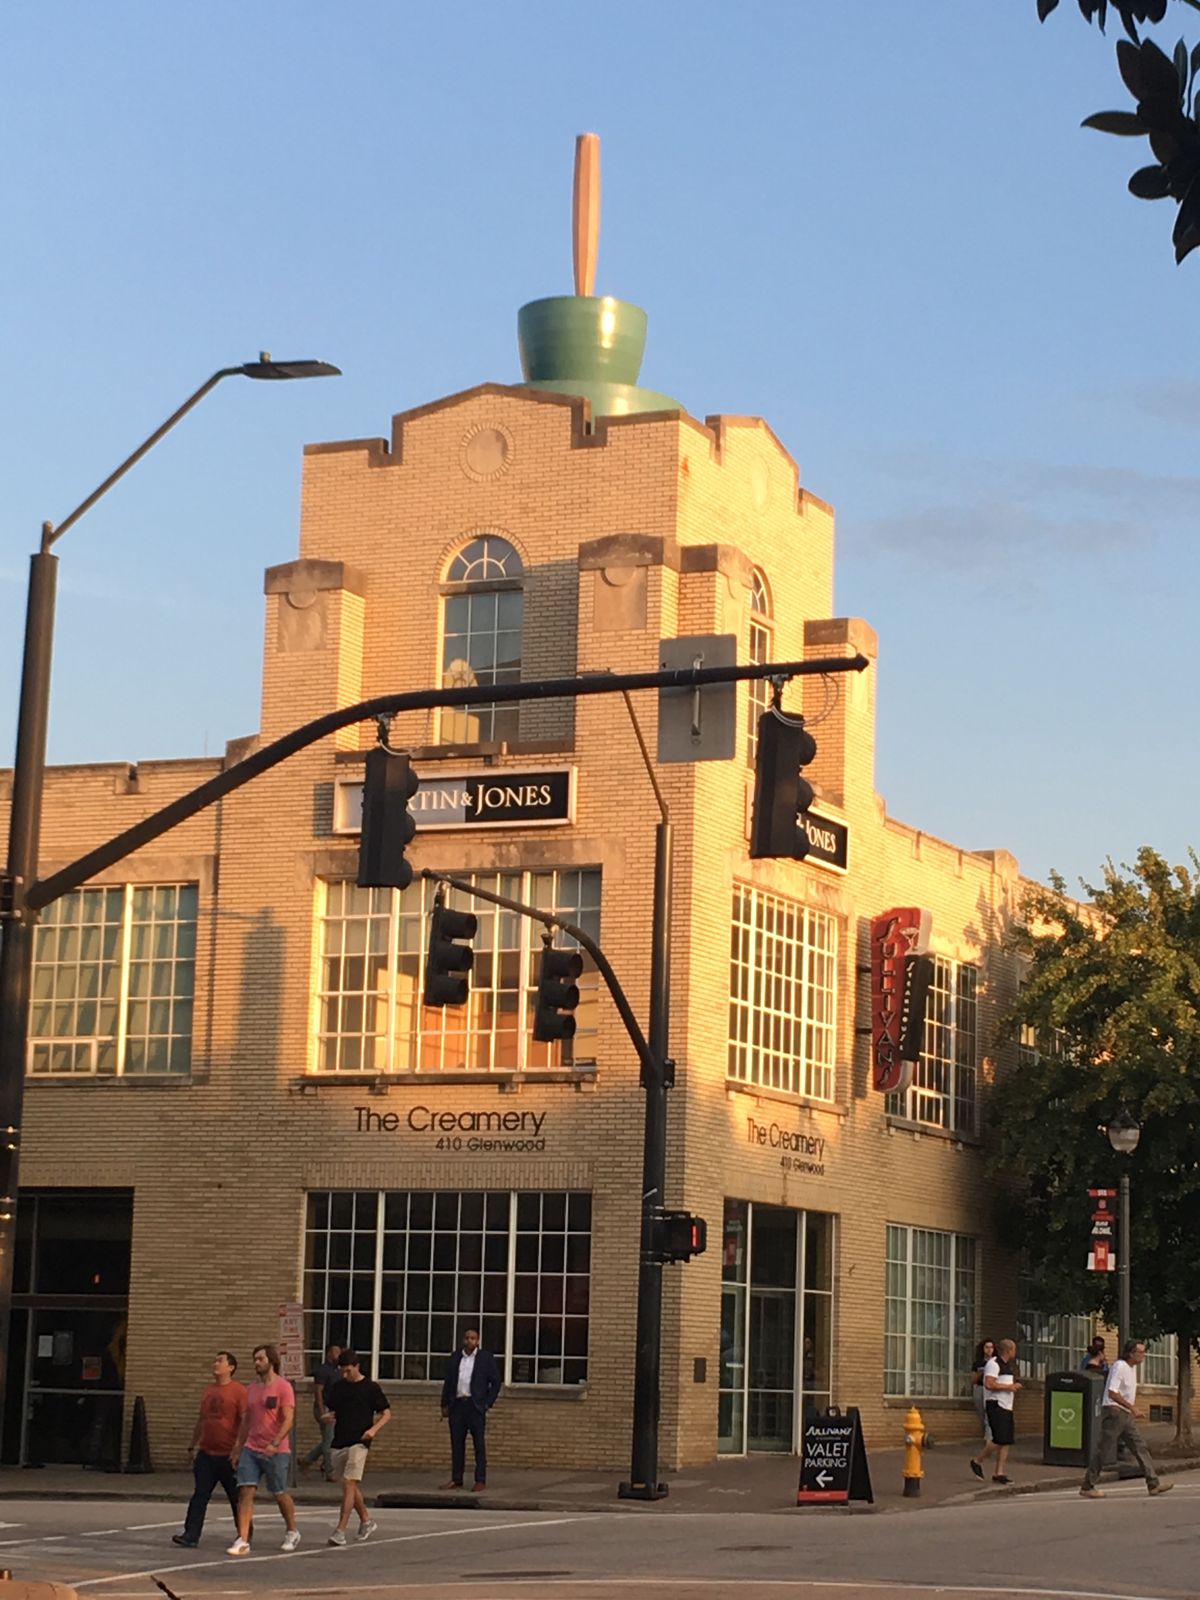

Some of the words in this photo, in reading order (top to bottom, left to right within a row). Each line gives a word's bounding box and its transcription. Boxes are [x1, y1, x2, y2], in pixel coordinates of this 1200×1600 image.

[354, 1107, 399, 1131] The
[408, 1106, 546, 1136] Creamery
[435, 1137, 462, 1150] 410
[467, 1137, 545, 1150] Glenwood
[747, 1117, 767, 1145] The
[769, 1123, 825, 1161] Creamery
[806, 1442, 849, 1457] VALET
[804, 1458, 847, 1468] PARKING
